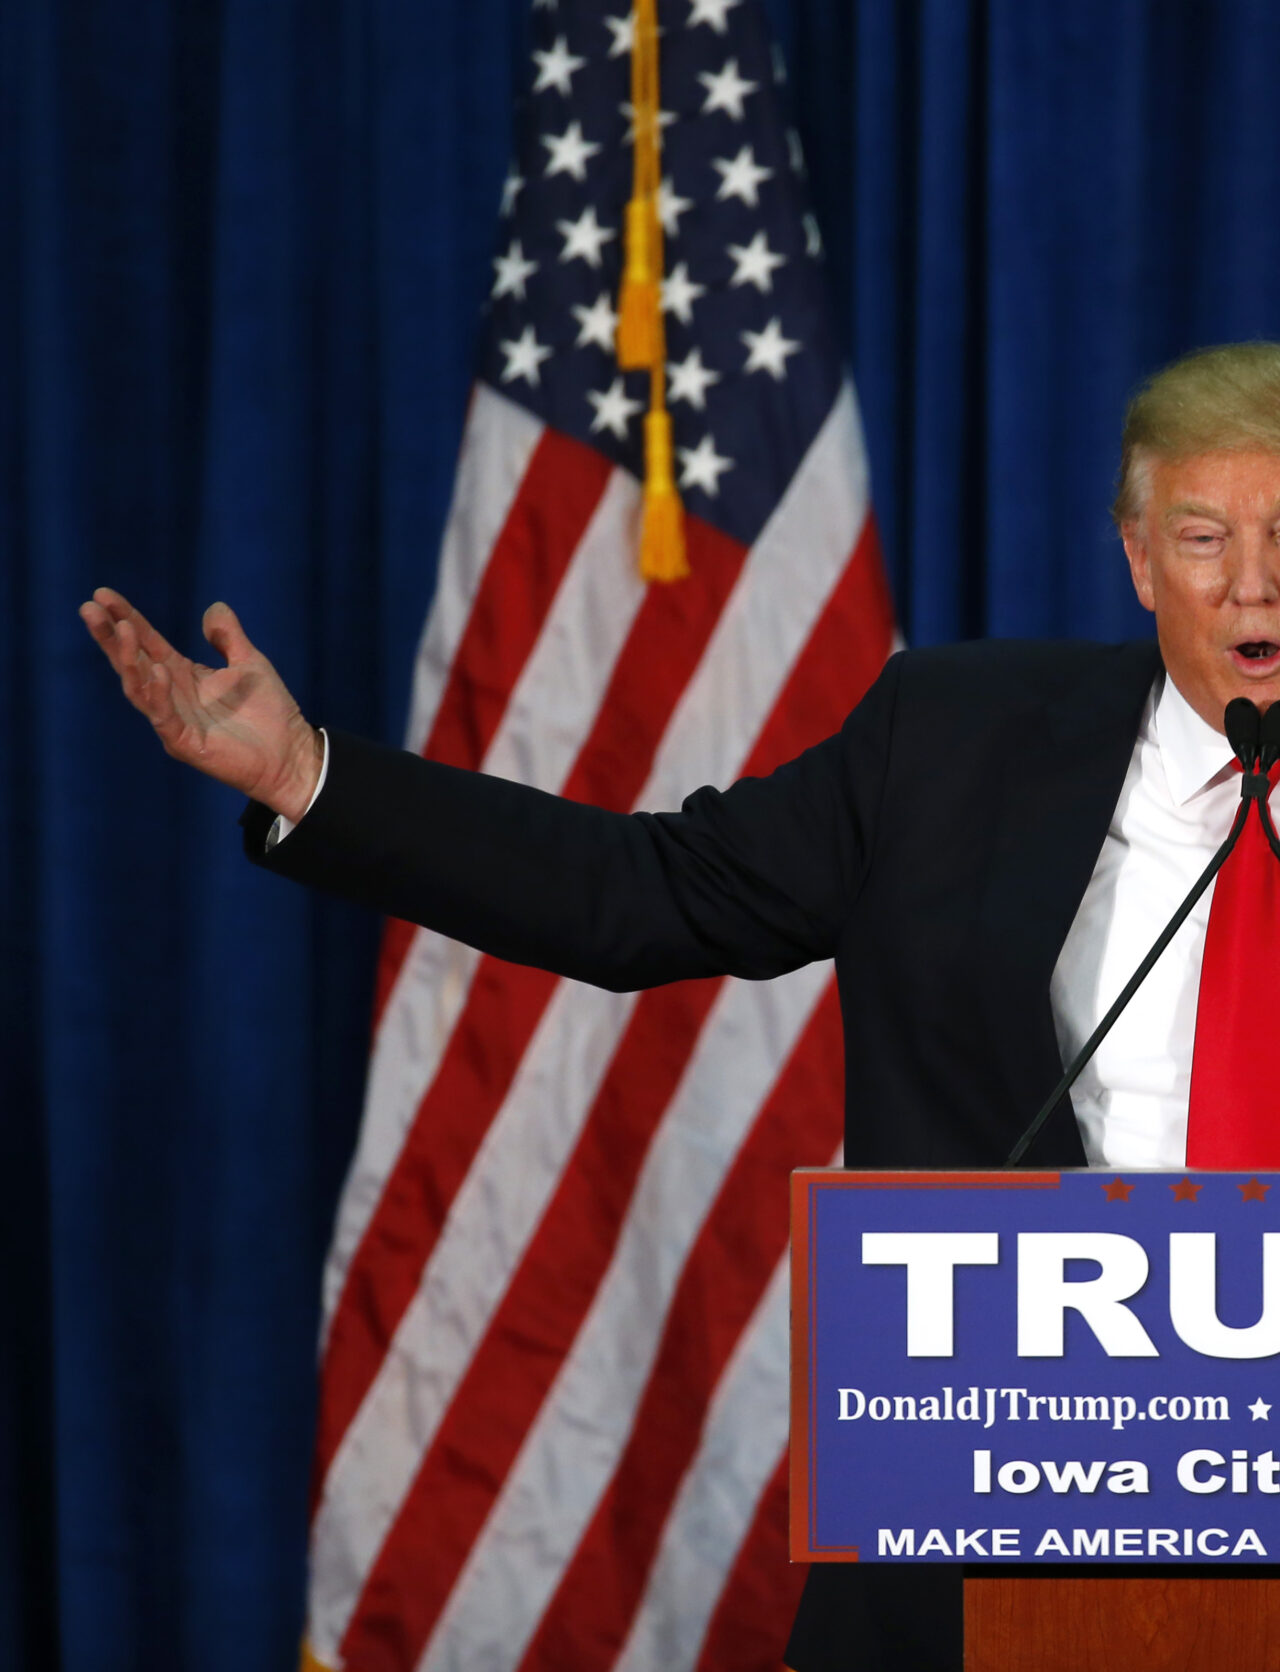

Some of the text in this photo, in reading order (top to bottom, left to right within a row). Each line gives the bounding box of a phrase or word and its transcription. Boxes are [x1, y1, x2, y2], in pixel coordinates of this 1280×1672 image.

[837, 1386, 1231, 1430] DonaldJTrump.com
[973, 1448, 1150, 1494] Iowa
[877, 1527, 1021, 1557] MAKE
[1034, 1527, 1268, 1557] AMERICA
